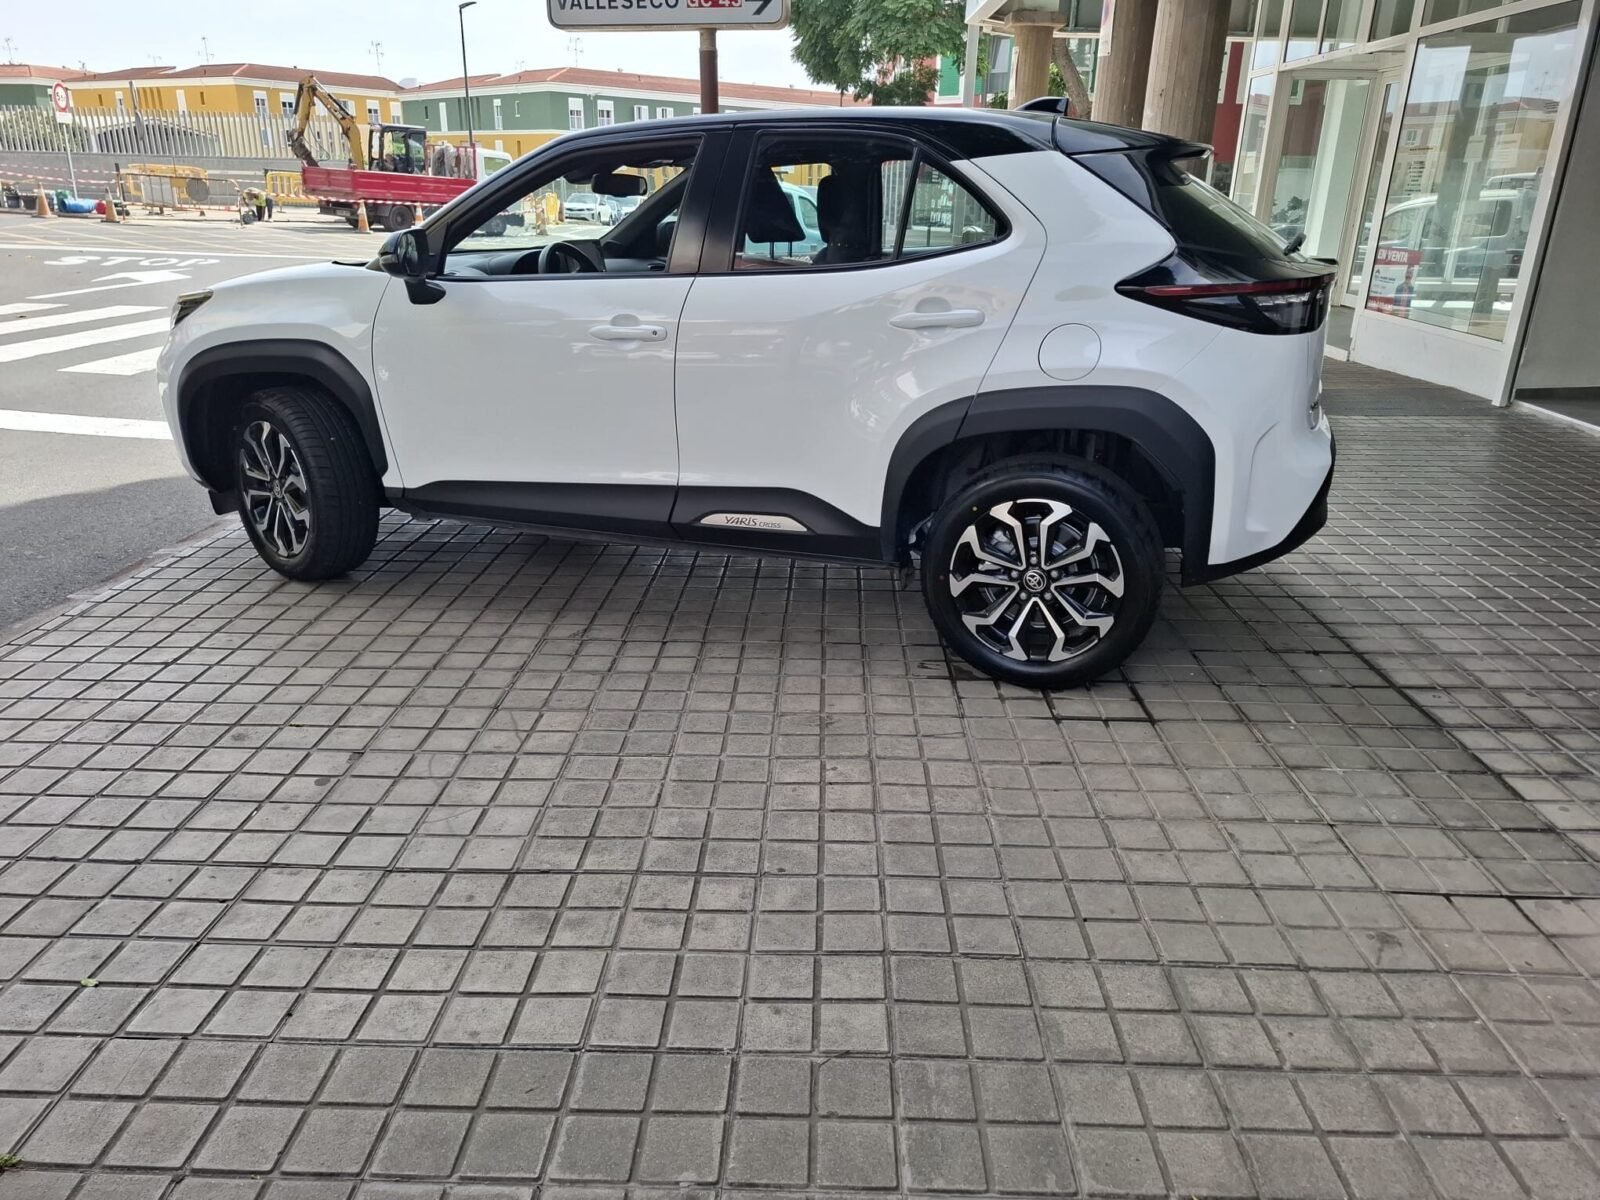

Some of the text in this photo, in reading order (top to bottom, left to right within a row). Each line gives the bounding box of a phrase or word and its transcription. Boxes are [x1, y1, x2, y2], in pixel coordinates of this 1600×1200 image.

[558, 0, 679, 10] VALLESECO
[43, 256, 220, 266] STOP
[1388, 249, 1408, 263] VENTA
[725, 515, 758, 527] YARIS
